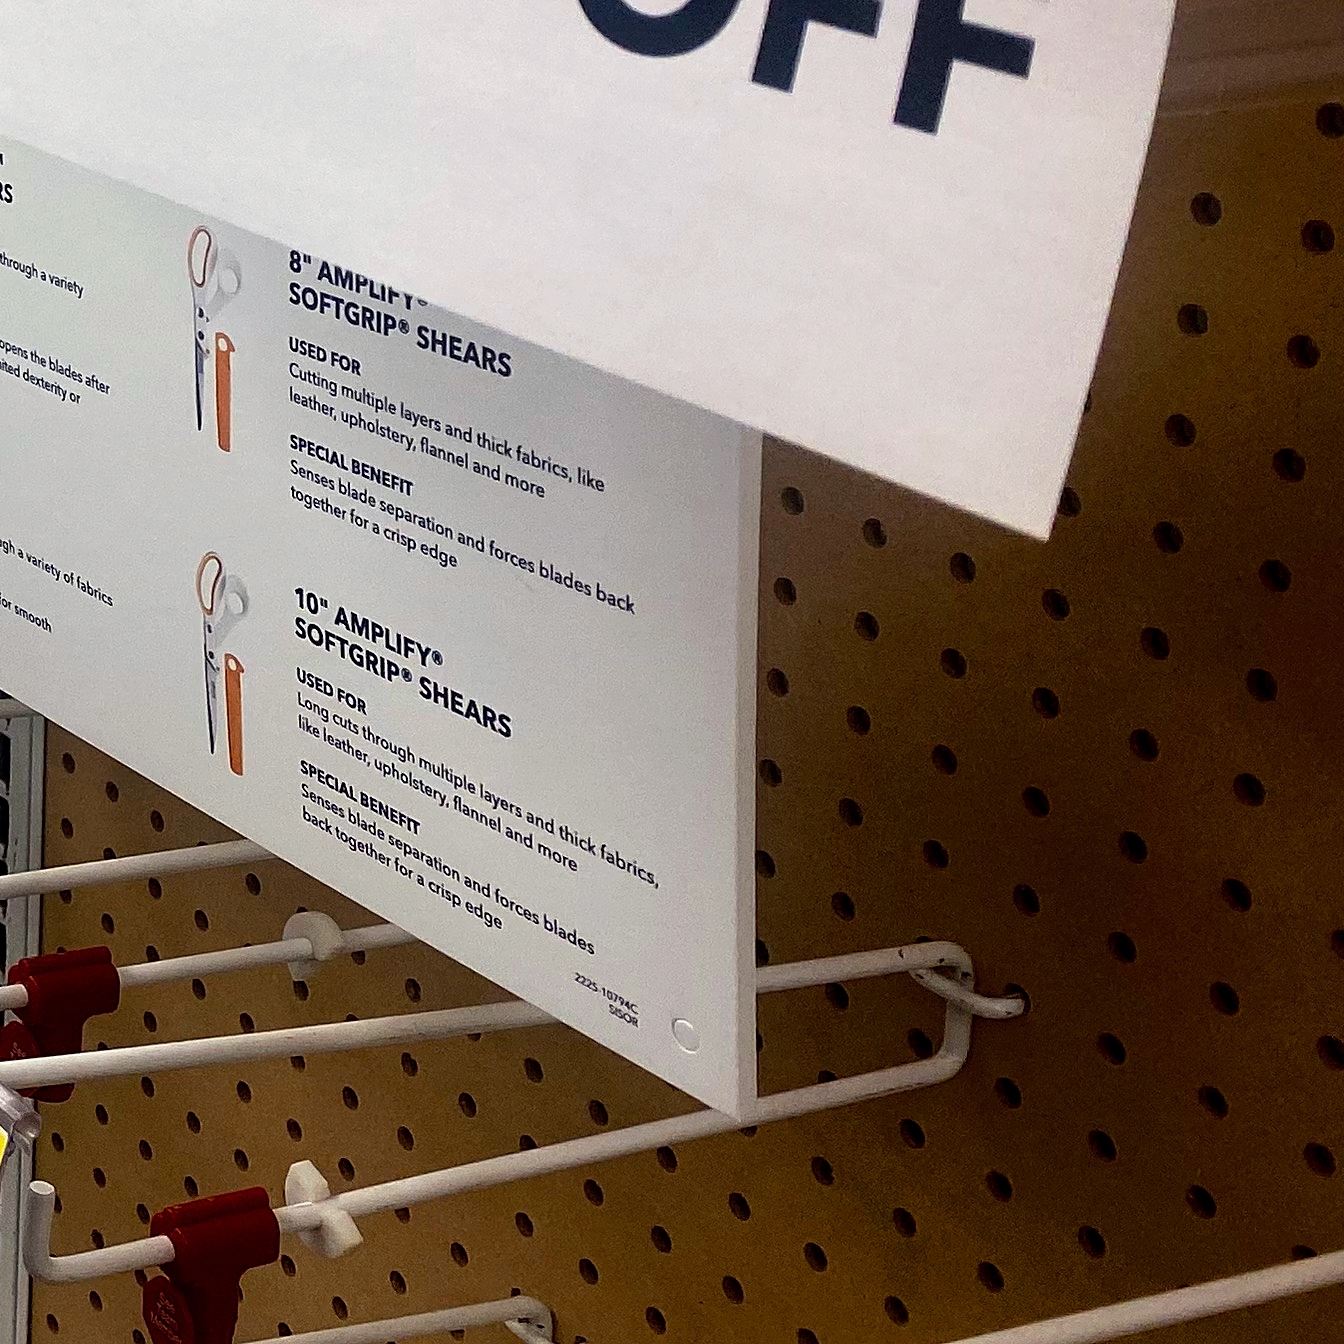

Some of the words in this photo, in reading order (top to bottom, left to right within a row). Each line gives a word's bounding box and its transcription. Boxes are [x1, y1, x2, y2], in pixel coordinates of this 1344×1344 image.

[0, 252, 38, 279] through
[41, 272, 46, 281] a
[49, 275, 83, 299] variety
[0, 340, 28, 359] opens
[30, 350, 46, 367] the
[49, 356, 82, 383] blades
[86, 375, 110, 394] after
[289, 337, 327, 362] USED
[331, 351, 361, 376] FOR
[417, 326, 511, 377] SHEARS
[290, 363, 337, 396] Cutting
[342, 386, 396, 414] multiple
[401, 402, 441, 431] layers
[445, 425, 472, 443] and
[477, 432, 512, 458] thick
[516, 445, 572, 483] fabrics,
[578, 467, 604, 492] like
[290, 387, 336, 421] leather,
[341, 411, 416, 451] upholstery,
[421, 437, 468, 469] flannel
[473, 462, 500, 481] and
[505, 474, 544, 498] more
[290, 435, 348, 470] SPECIAL
[352, 459, 413, 496] BENEFIT
[291, 486, 346, 520] together
[350, 509, 369, 529] for
[373, 523, 379, 534] a
[384, 529, 416, 552] crisp
[421, 544, 457, 567] edge
[291, 460, 334, 490] Senses
[339, 478, 376, 507] blade
[380, 501, 453, 539] separation
[458, 533, 484, 552] and
[489, 540, 534, 573] forces
[540, 560, 591, 596] blades
[597, 583, 635, 614] back
[297, 667, 333, 696] USED
[338, 688, 367, 715] FOR
[419, 676, 511, 737] SHEARS
[298, 692, 328, 722] Long
[333, 714, 358, 735] cuts
[362, 726, 415, 763] through
[419, 758, 475, 794] multiple
[480, 784, 522, 817] layers
[527, 812, 554, 834] and
[559, 826, 596, 856] thick
[601, 844, 658, 889] fabrics,
[299, 714, 320, 738] like
[324, 727, 370, 767] leather,
[375, 759, 449, 808] upholstery,
[453, 795, 501, 833] flannel
[506, 827, 533, 849] and
[538, 844, 577, 871] more
[301, 760, 357, 802] SPECIAL
[360, 792, 420, 835] BENEFIT
[302, 784, 345, 818] Senses
[348, 808, 384, 840] blade
[389, 835, 460, 882] separation
[464, 876, 490, 898] and
[495, 889, 539, 924] forces
[544, 914, 594, 954] blades
[303, 805, 332, 835] back
[335, 827, 391, 866] together
[395, 857, 413, 879] for
[417, 875, 424, 886] a
[429, 882, 461, 907] crisp
[466, 902, 502, 929] edge
